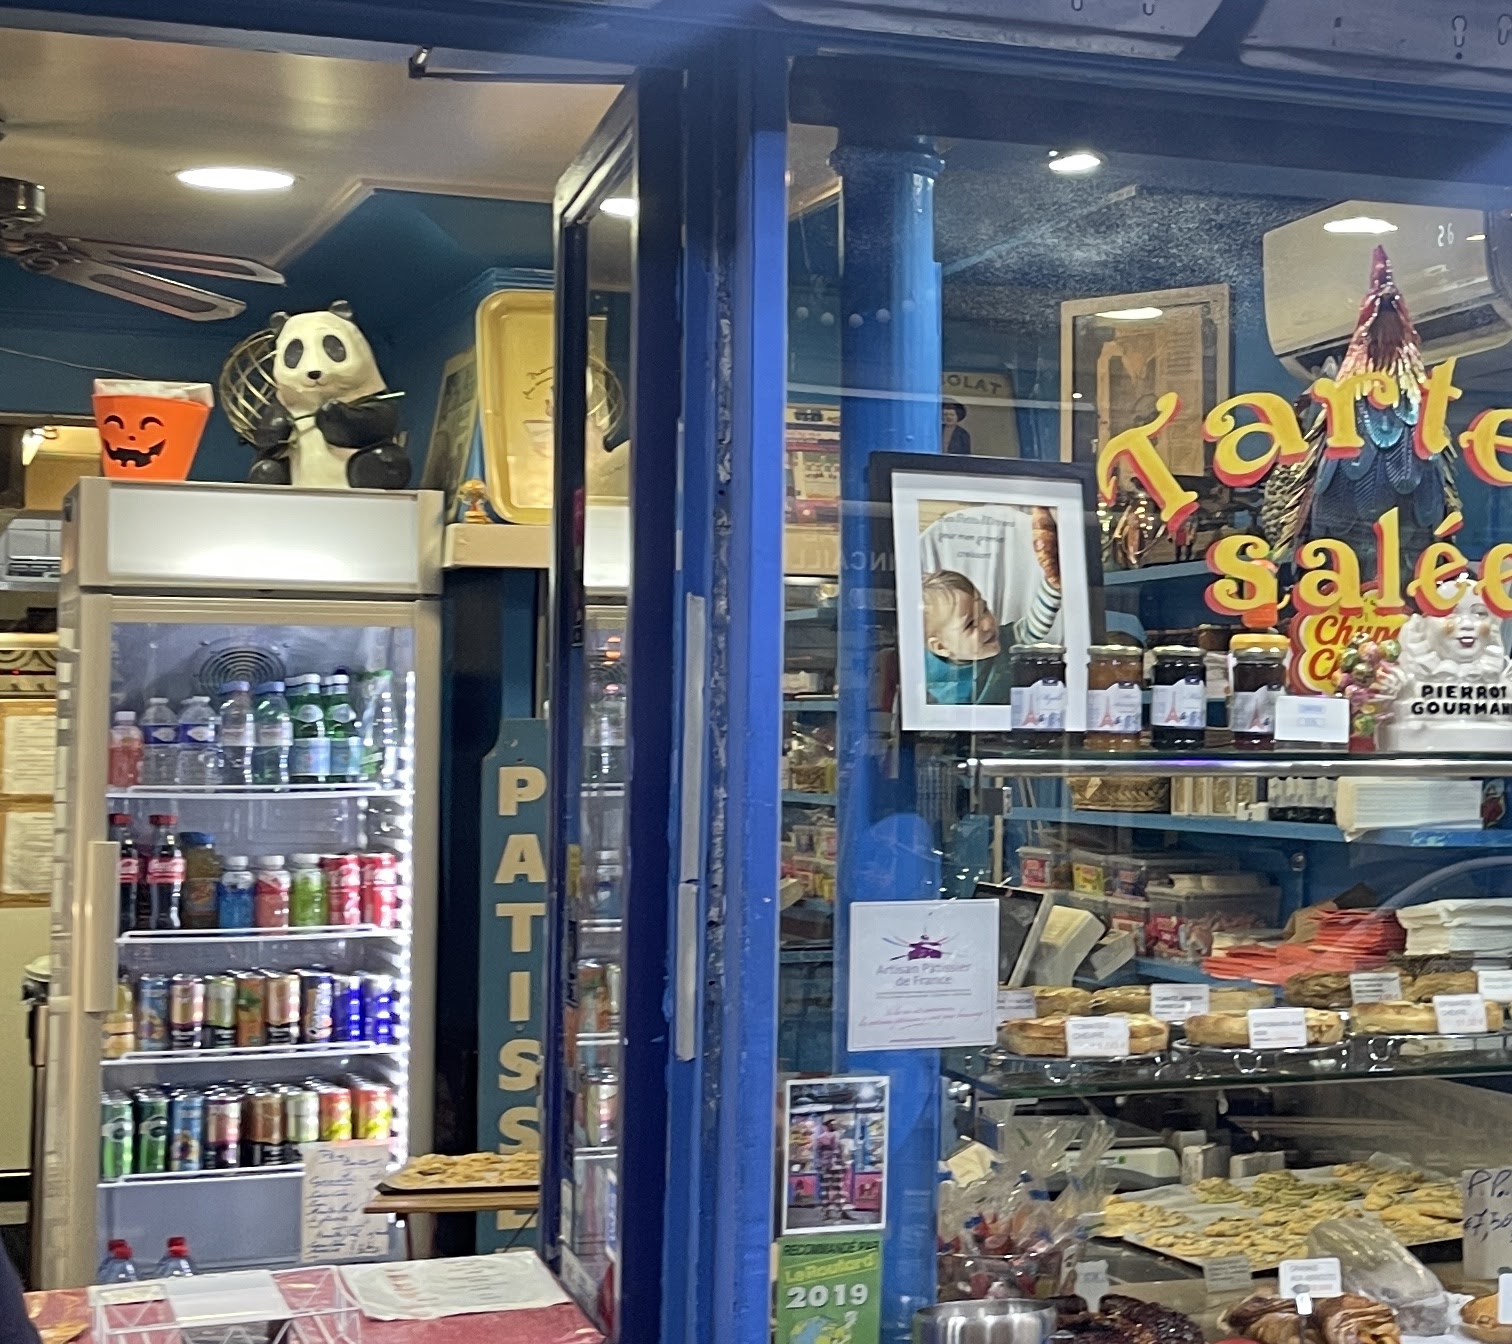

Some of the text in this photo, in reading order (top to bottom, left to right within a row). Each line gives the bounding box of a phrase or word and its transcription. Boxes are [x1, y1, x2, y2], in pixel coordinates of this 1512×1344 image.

[1437, 222, 1455, 247] 26
[941, 374, 1002, 394] OLAT
[1421, 684, 1507, 700] PIERROT
[785, 1283, 869, 1309] 2019
